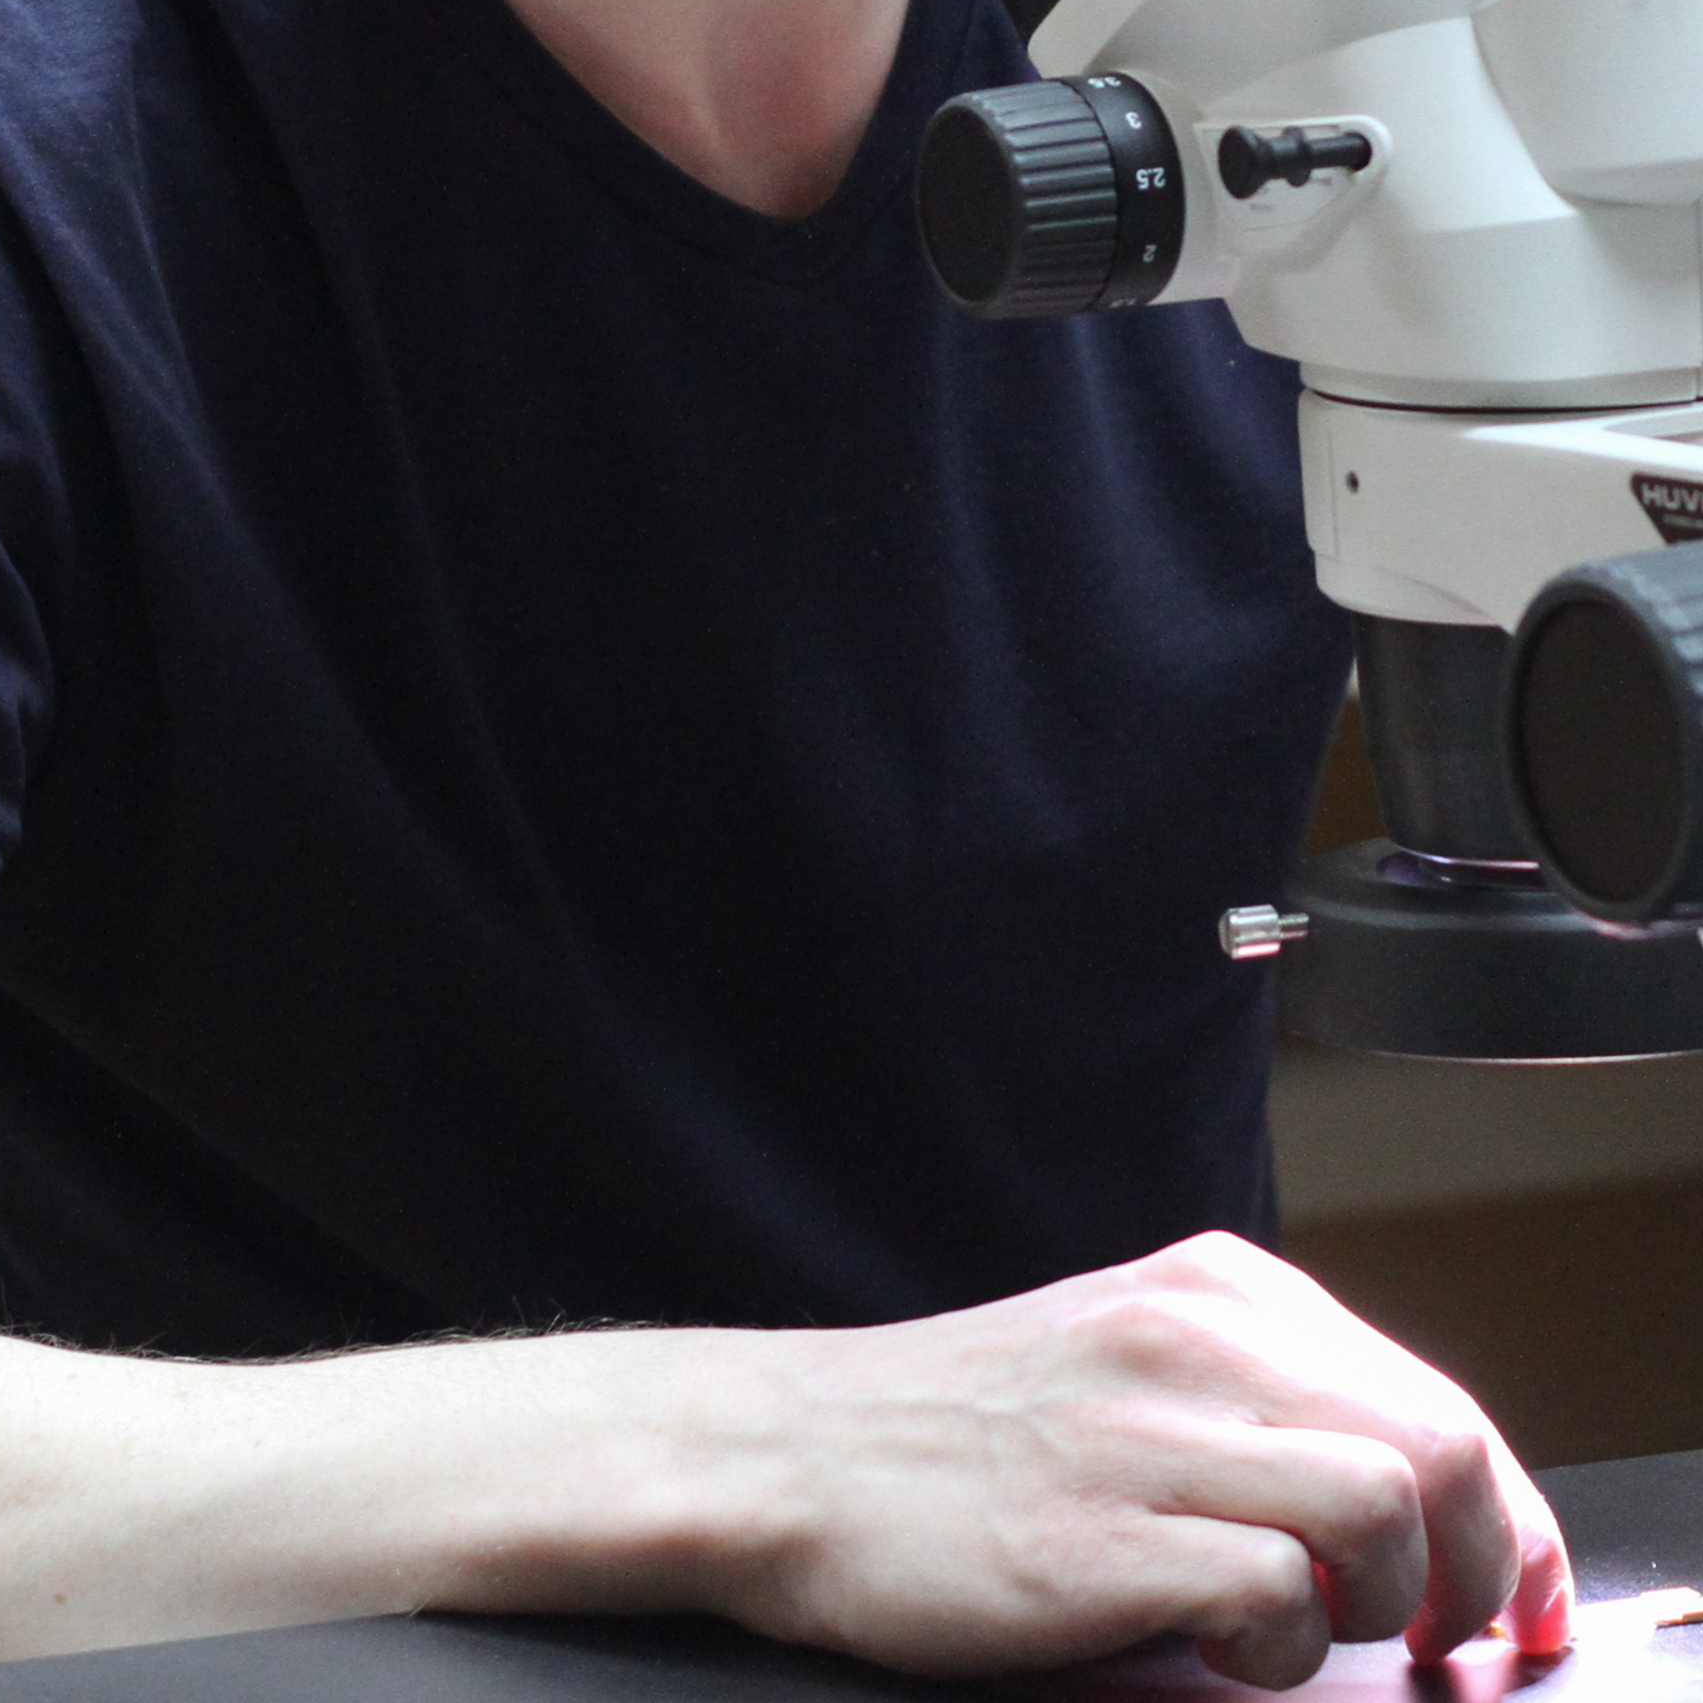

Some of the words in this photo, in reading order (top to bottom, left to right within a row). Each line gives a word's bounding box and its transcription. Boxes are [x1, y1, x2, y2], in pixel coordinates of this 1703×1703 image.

[1125, 111, 1143, 130] 3
[1136, 167, 1166, 190] 2.5
[1142, 244, 1158, 263] 2
